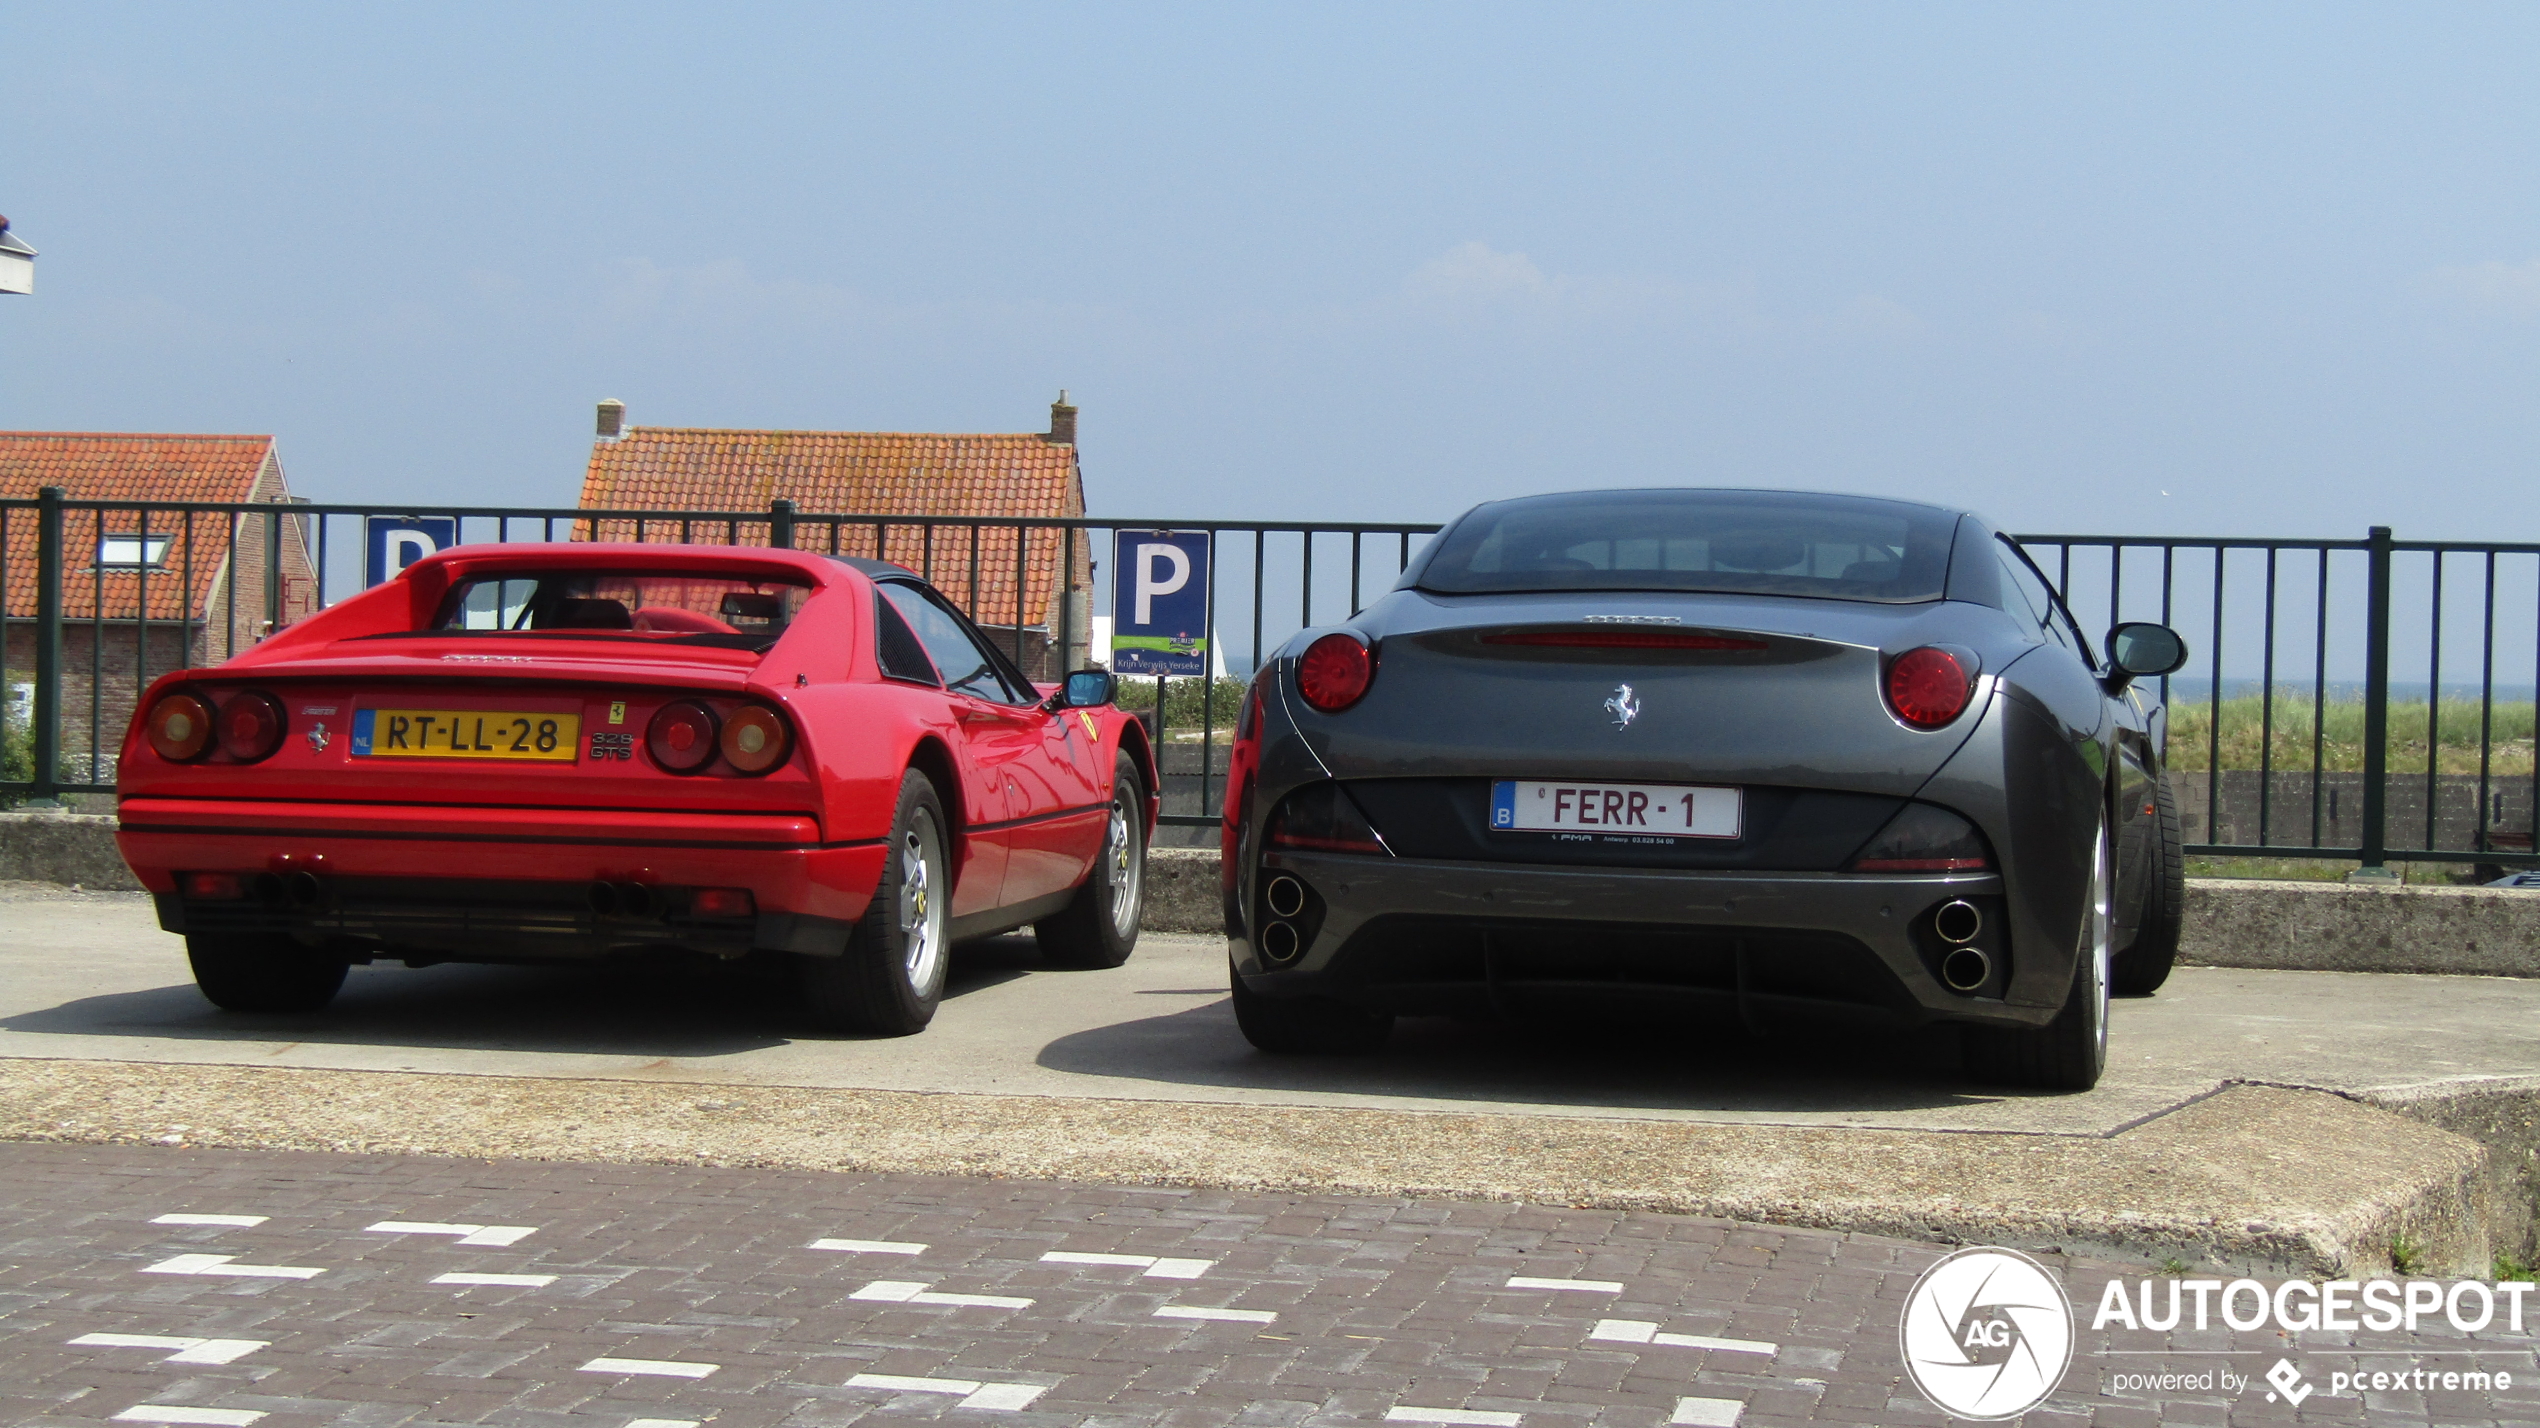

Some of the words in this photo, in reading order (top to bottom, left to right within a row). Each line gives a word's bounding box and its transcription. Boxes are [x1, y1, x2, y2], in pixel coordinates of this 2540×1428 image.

[385, 529, 437, 582] P
[1135, 543, 1191, 625] P
[1117, 659, 1137, 670] Krijn
[1139, 660, 1167, 671] Verwijs
[1168, 661, 1200, 671] Yerseke
[387, 716, 559, 753] RT-LL-28
[592, 732, 634, 745] 328
[355, 736, 370, 748] NL
[590, 746, 633, 759] GTS
[1497, 808, 1511, 824] B
[1602, 835, 1629, 844] Antwerp
